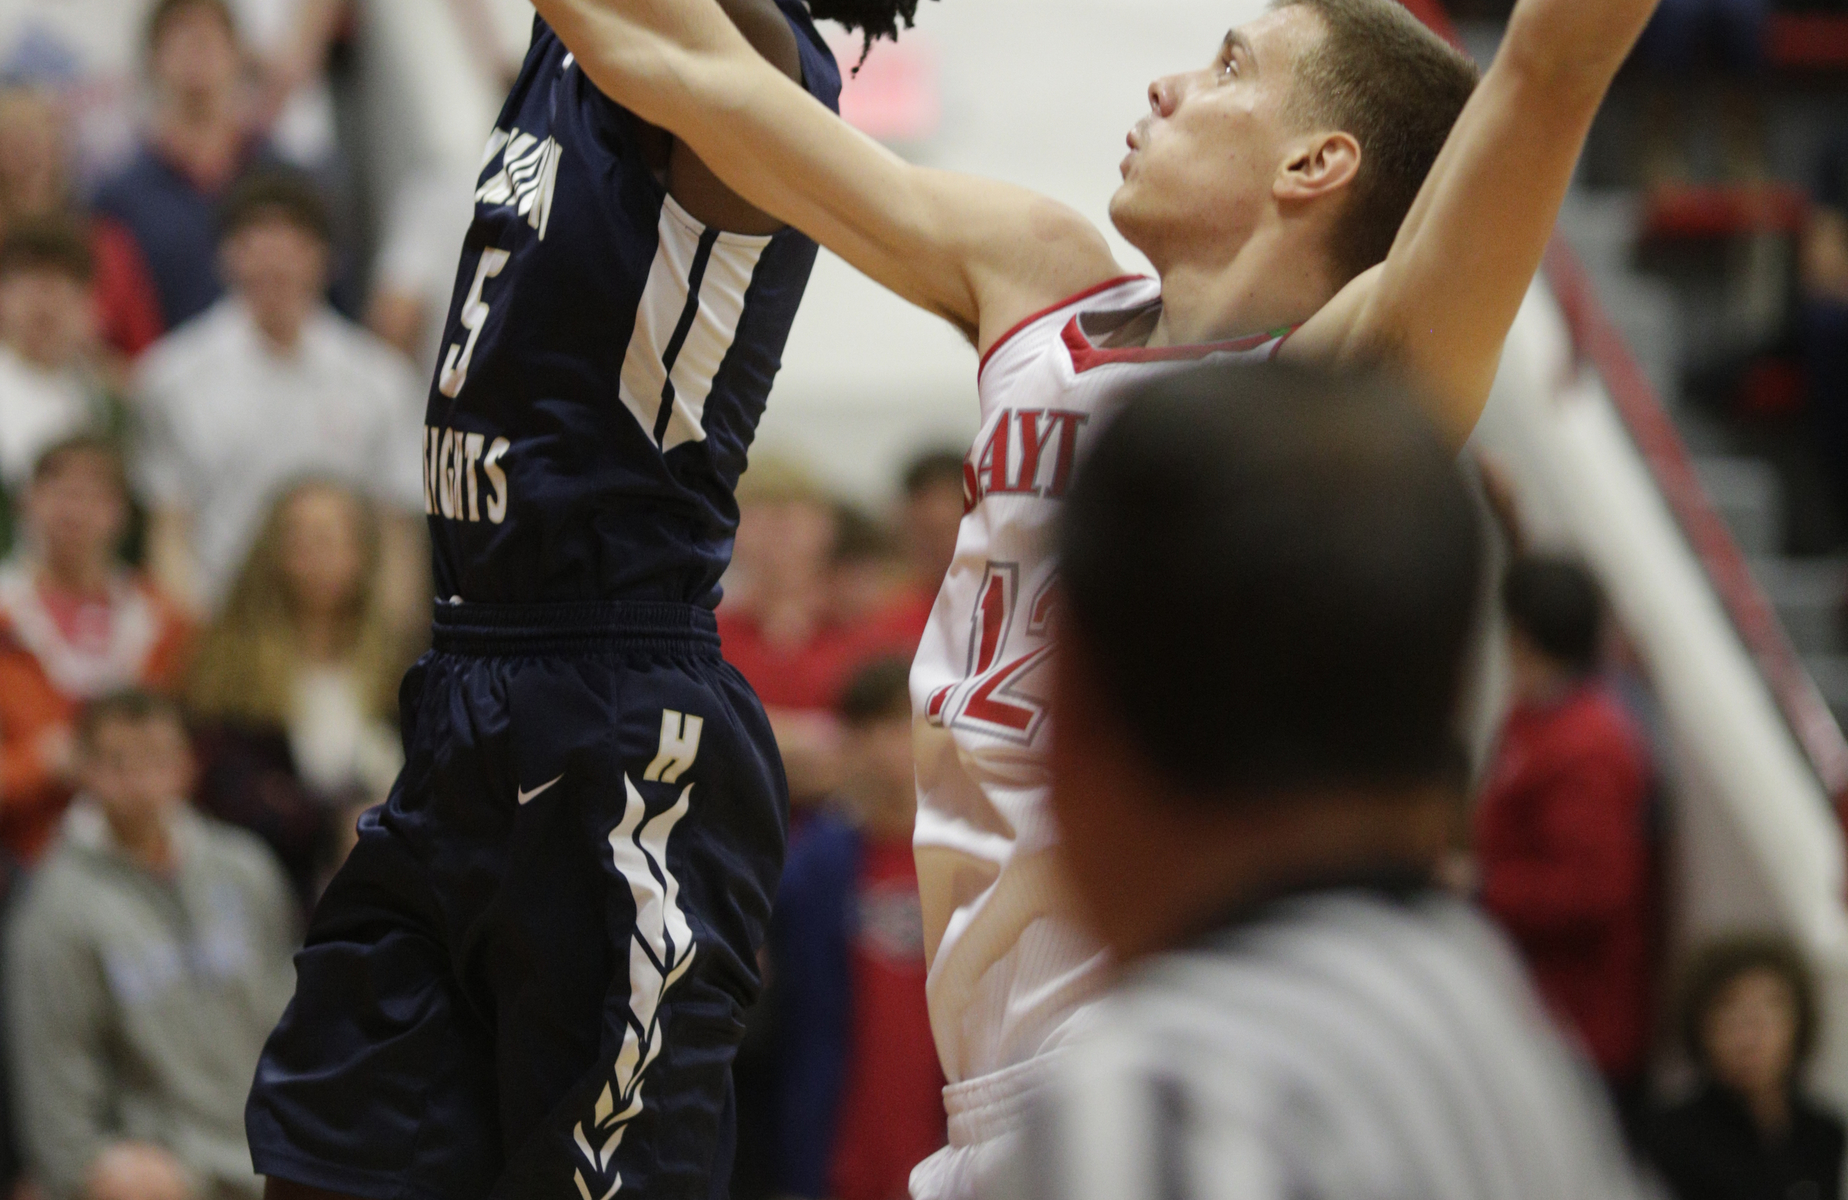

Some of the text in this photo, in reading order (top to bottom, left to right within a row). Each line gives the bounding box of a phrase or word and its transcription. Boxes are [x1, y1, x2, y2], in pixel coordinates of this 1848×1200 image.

[438, 246, 511, 399] 5
[925, 560, 1062, 746] 12
[642, 708, 704, 784] H
